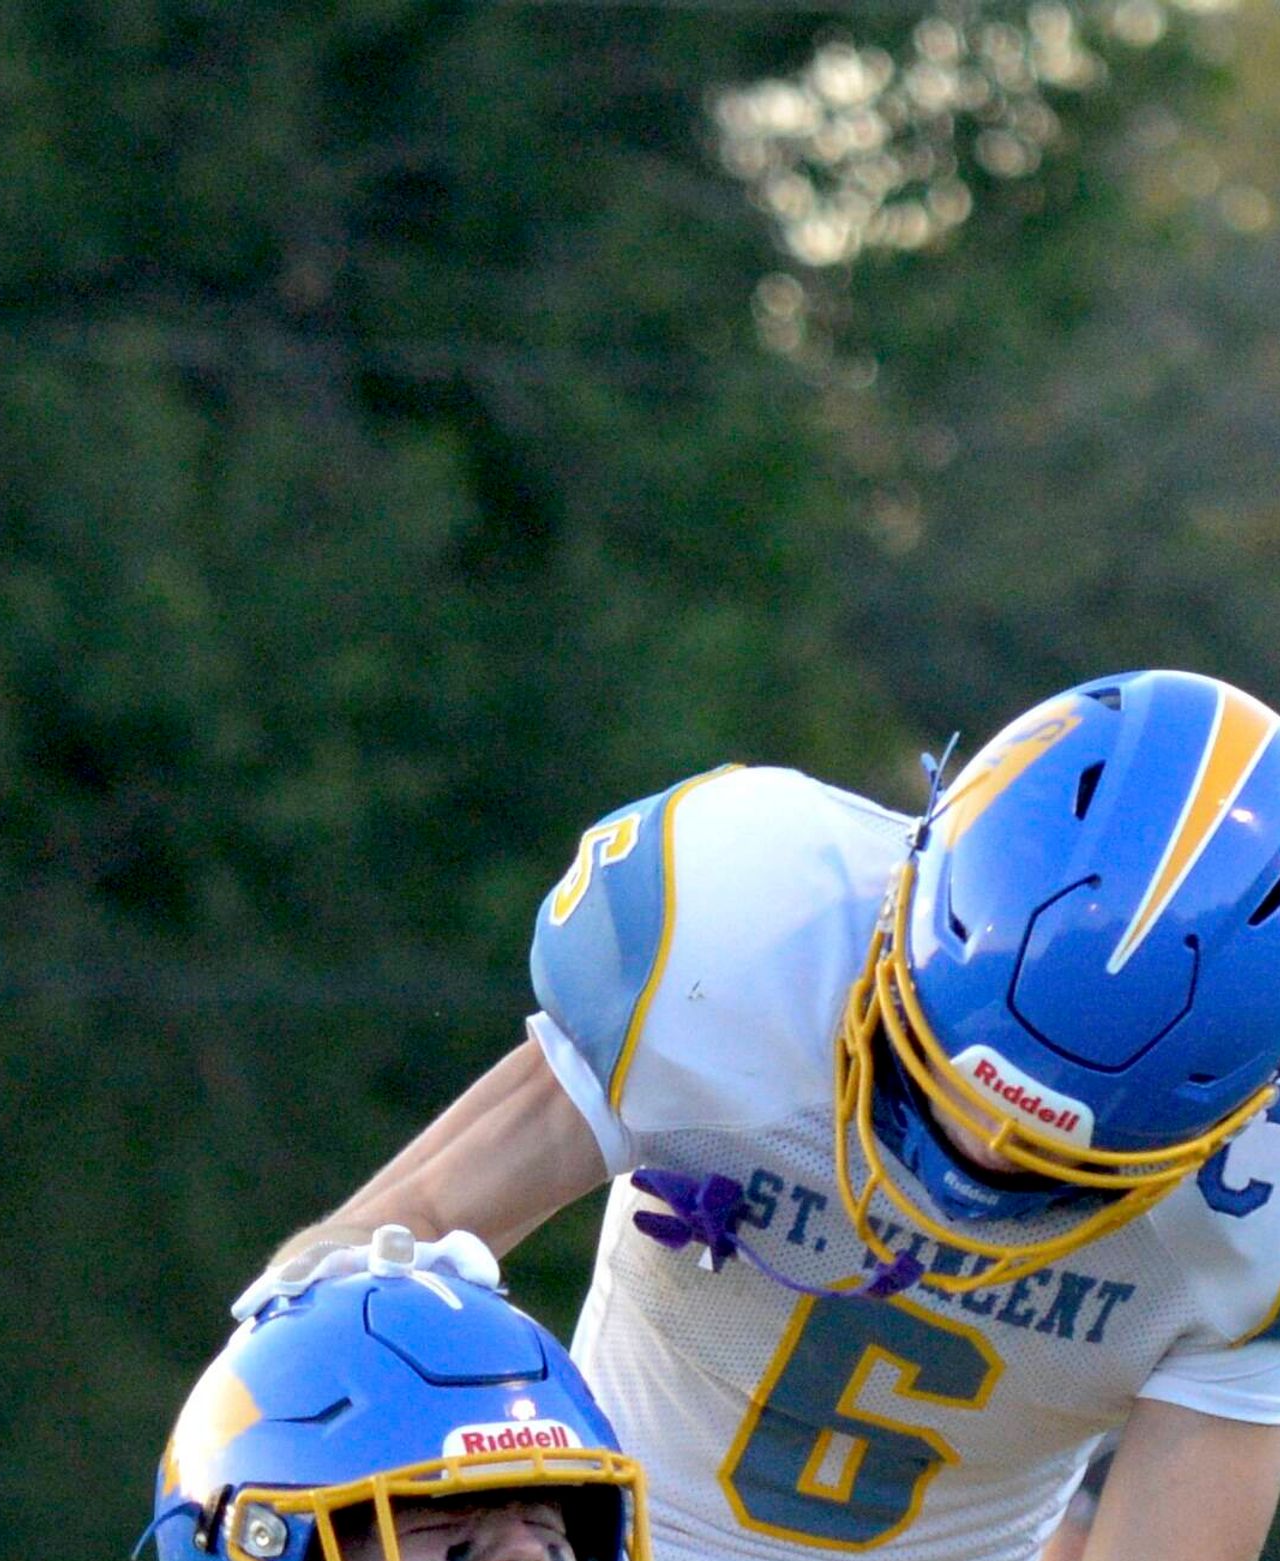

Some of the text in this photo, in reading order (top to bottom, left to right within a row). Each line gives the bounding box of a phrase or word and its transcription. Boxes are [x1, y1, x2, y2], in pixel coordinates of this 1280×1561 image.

[973, 1058, 1081, 1133] Riddell
[744, 1167, 828, 1252] ST.
[461, 1425, 569, 1457] Riddell
[716, 1274, 1006, 1553] 6
